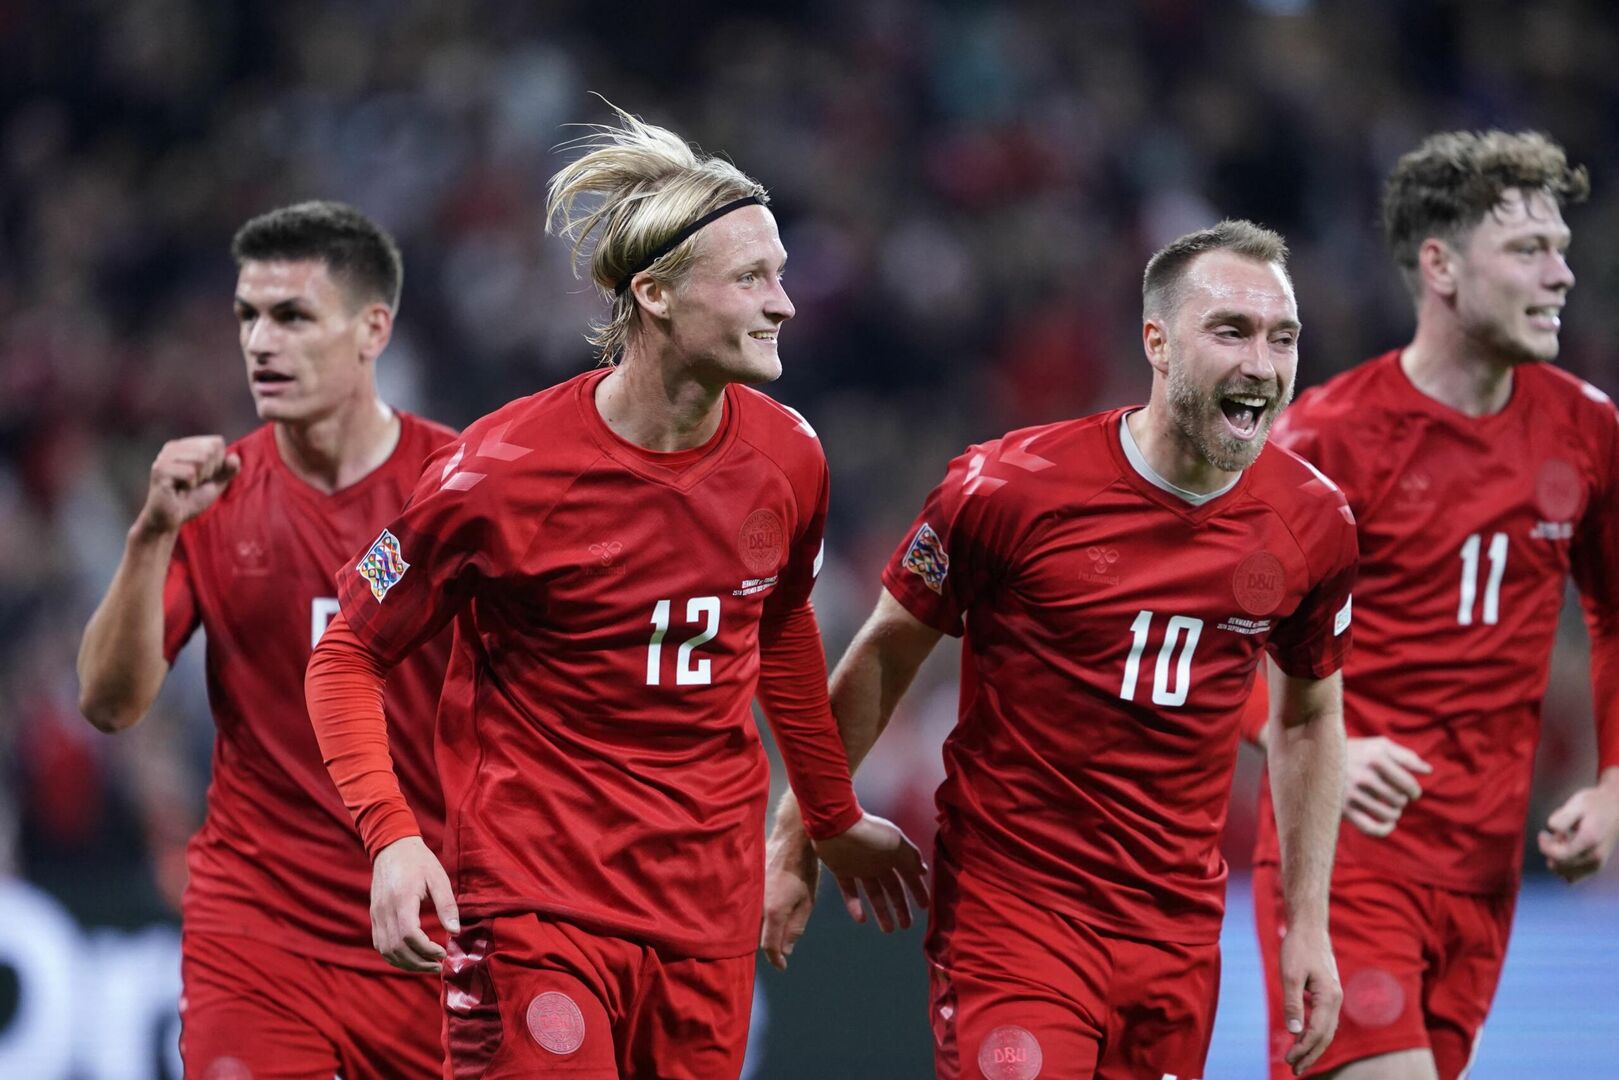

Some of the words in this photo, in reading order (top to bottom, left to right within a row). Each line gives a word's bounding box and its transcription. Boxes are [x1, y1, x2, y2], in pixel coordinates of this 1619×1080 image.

[1457, 532, 1509, 626] 11
[646, 596, 721, 686] 12
[1119, 610, 1204, 707] 10
[993, 1047, 1026, 1063] DBU
